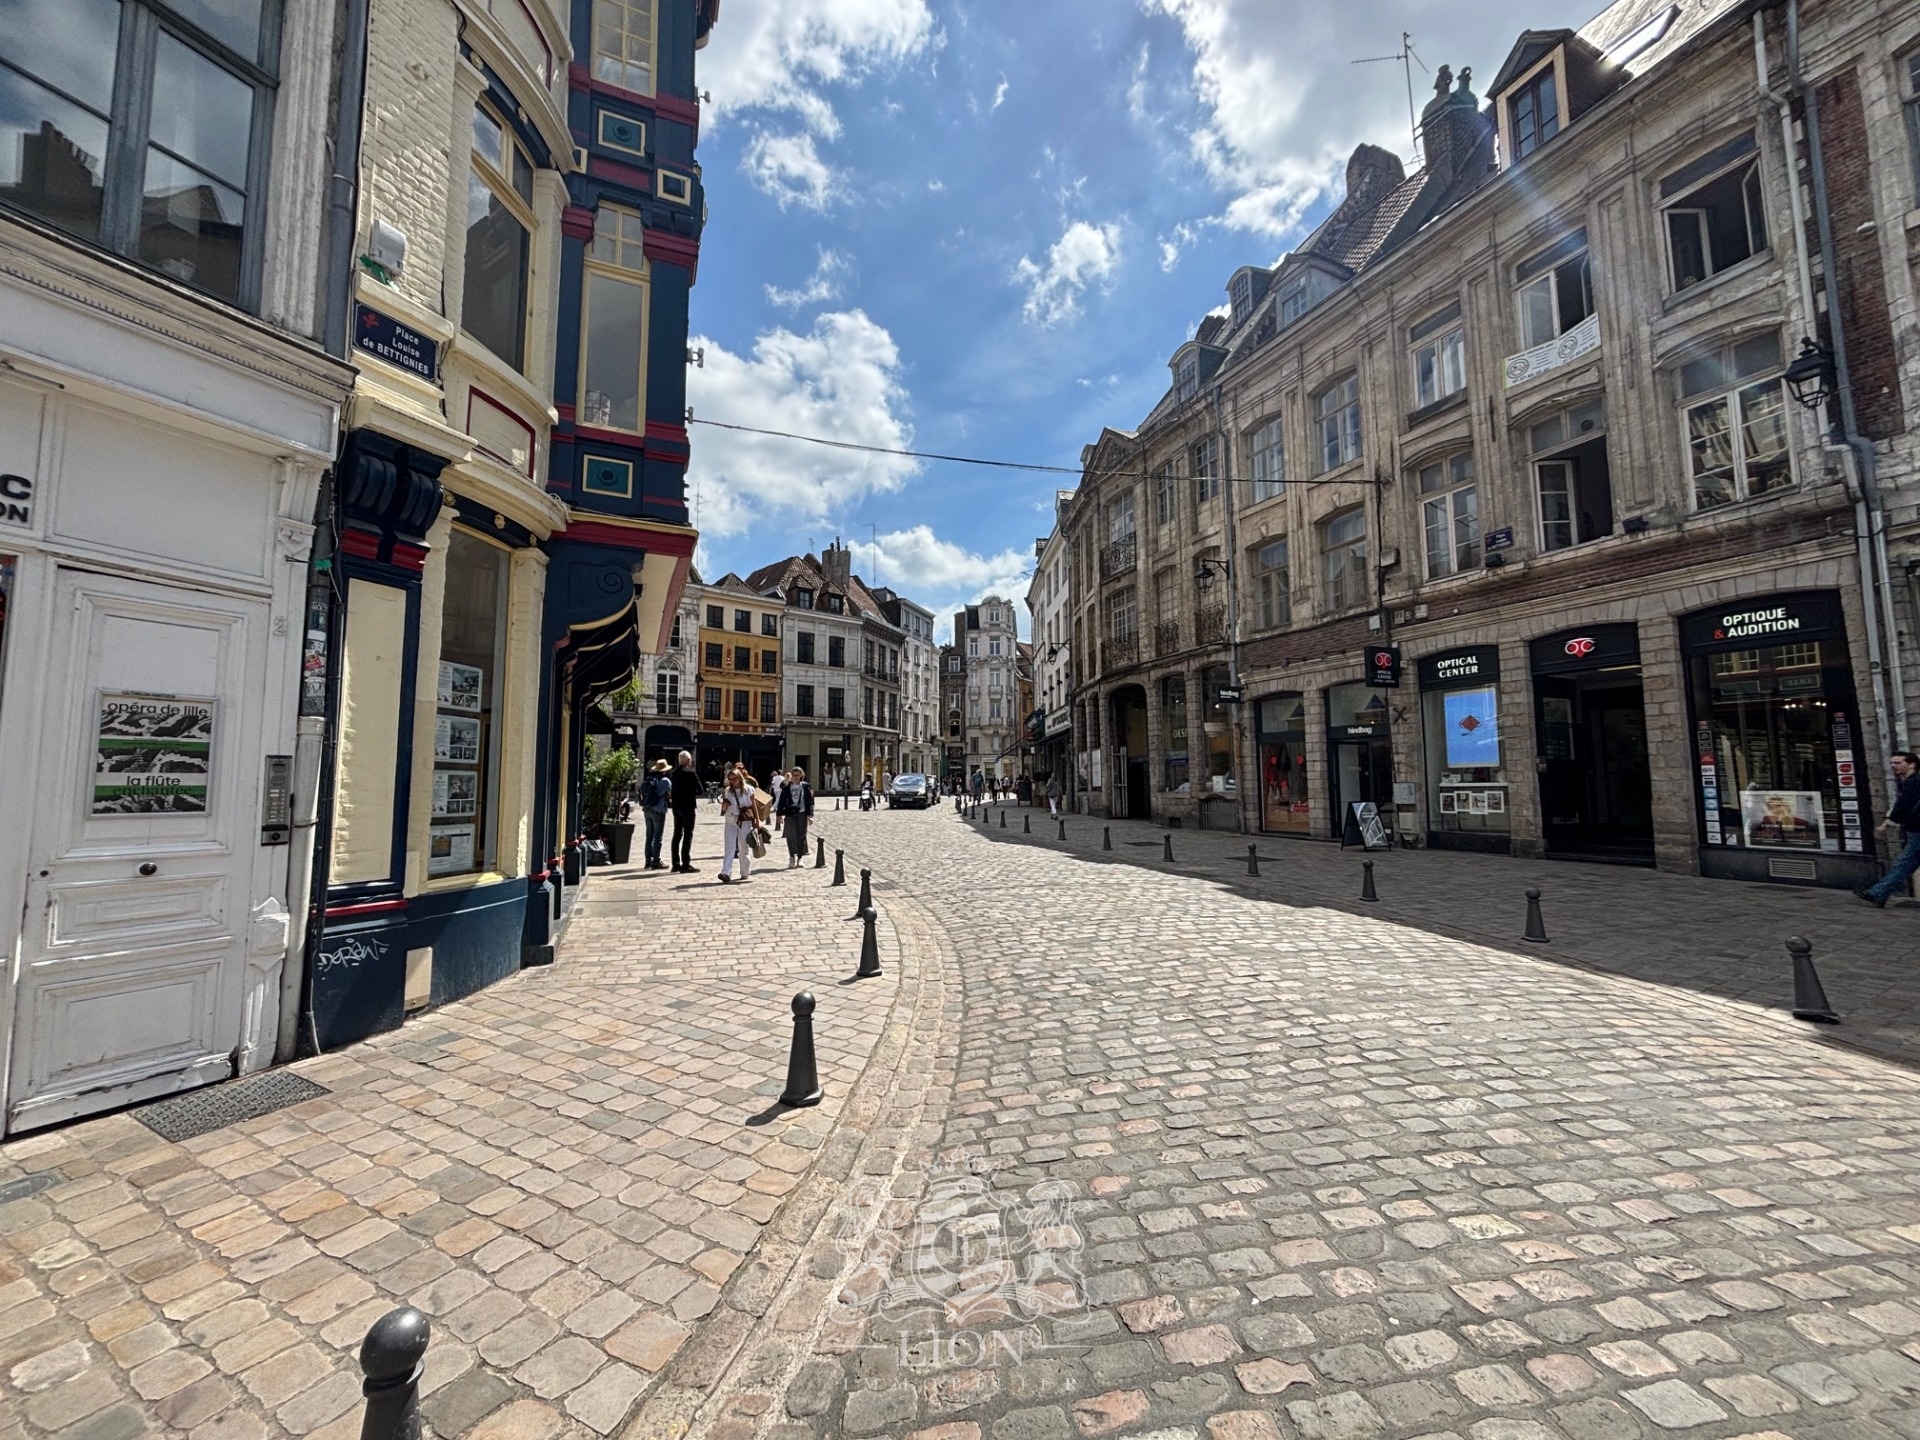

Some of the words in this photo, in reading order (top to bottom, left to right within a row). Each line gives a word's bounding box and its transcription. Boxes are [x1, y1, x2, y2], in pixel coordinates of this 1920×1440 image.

[395, 326, 419, 345] Place
[362, 337, 375, 349] de
[377, 343, 429, 374] BETTIGNIES
[392, 337, 420, 358] Louise
[273, 616, 288, 635] 2
[1723, 607, 1787, 626] OPTIQUE
[1714, 629, 1726, 639] &
[1727, 618, 1800, 638] AUDITION
[1437, 655, 1479, 669] OPTICAL
[1438, 665, 1479, 678] CENTER
[107, 702, 157, 716] opéra
[160, 704, 180, 715] de
[184, 705, 208, 717] lille
[126, 776, 141, 786] la
[145, 775, 181, 787] flûte
